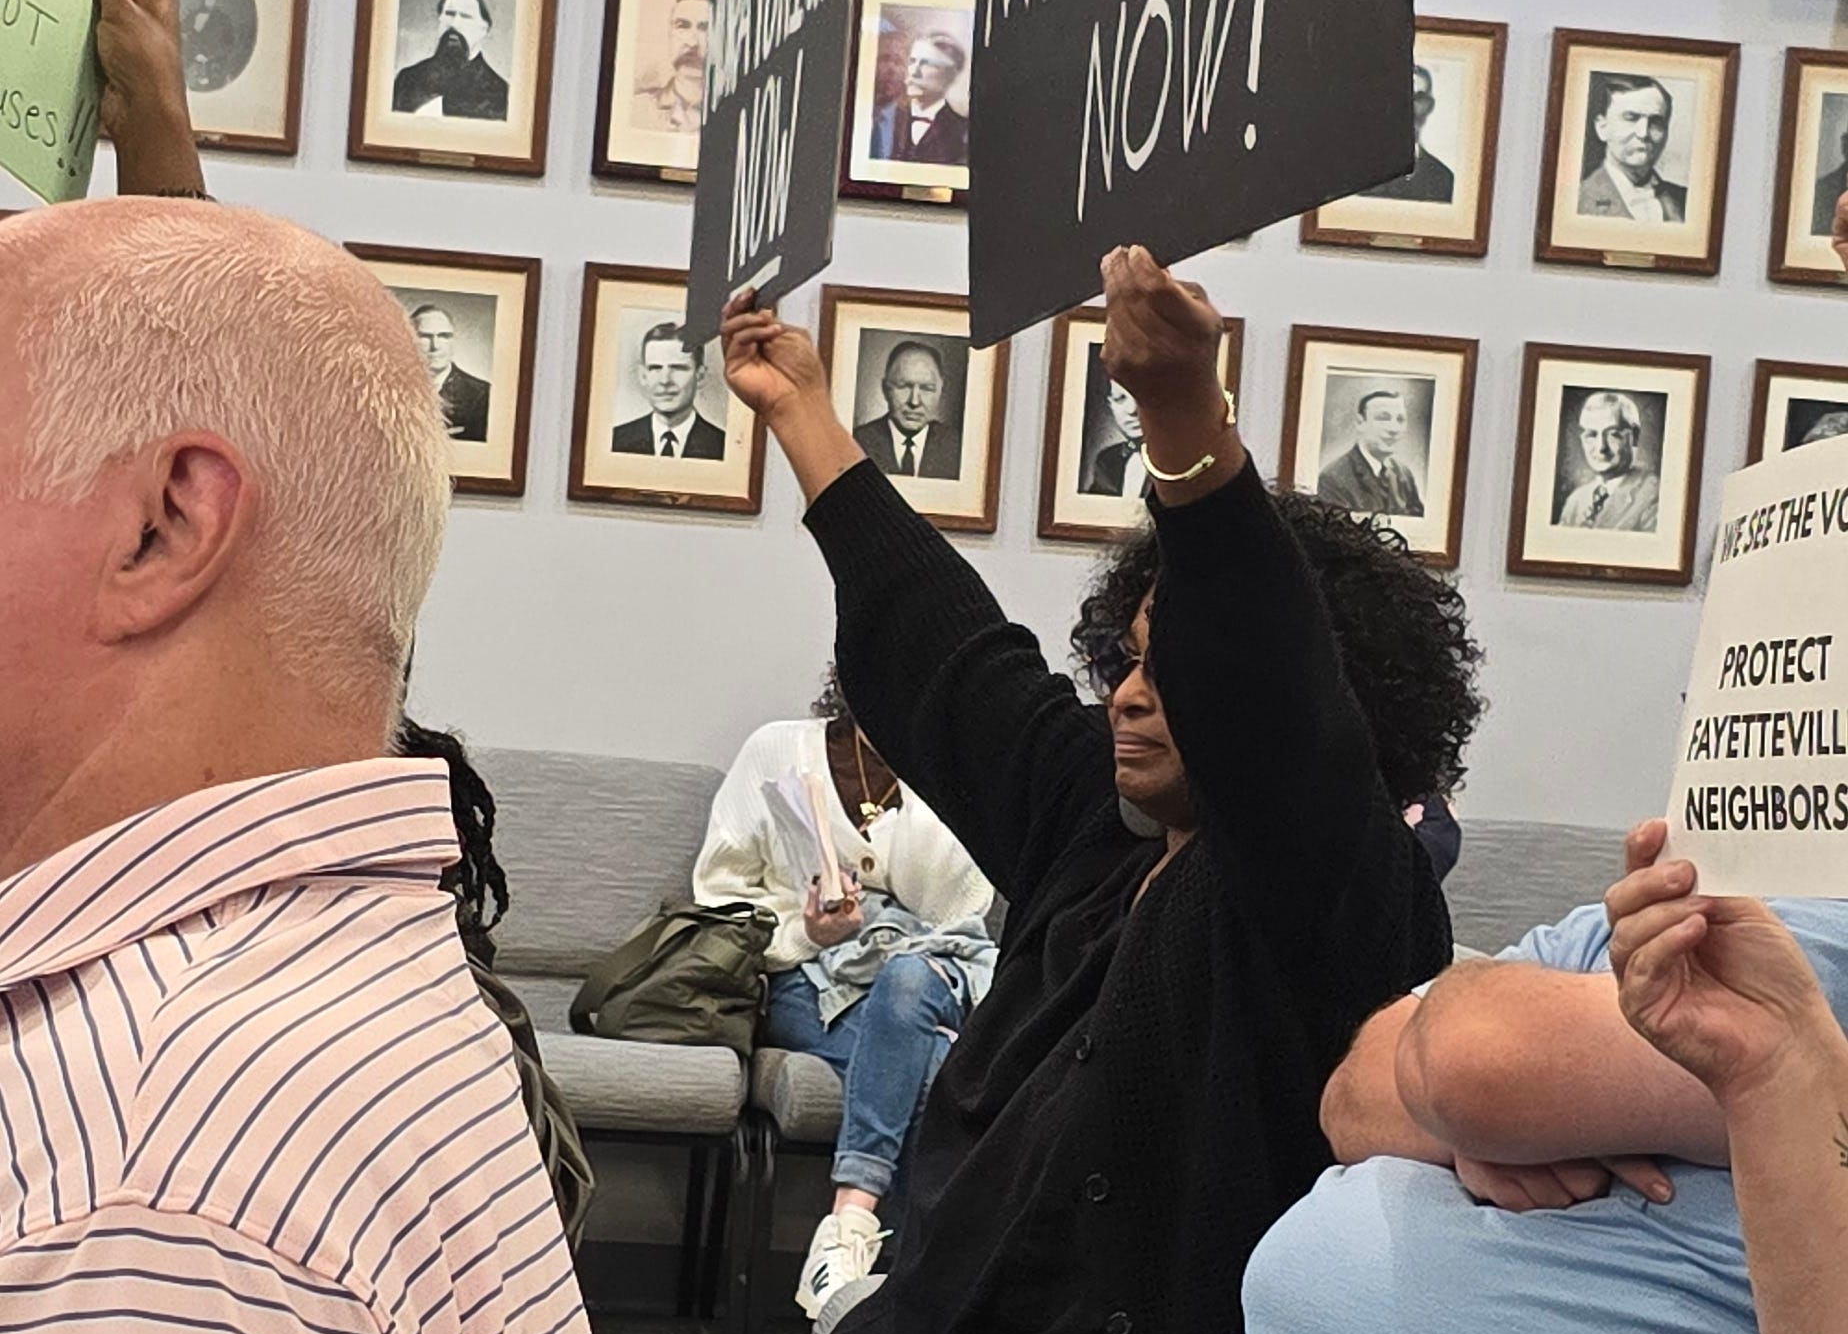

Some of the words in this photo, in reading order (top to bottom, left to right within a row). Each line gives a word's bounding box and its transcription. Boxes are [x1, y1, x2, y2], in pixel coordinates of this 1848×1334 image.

[1742, 503, 1777, 555] SEE
[1775, 492, 1818, 544] THE
[1718, 634, 1833, 691] PROTECT
[1686, 708, 1848, 763] FAYETTEVILL
[1685, 783, 1848, 832] NEIGHBORS
